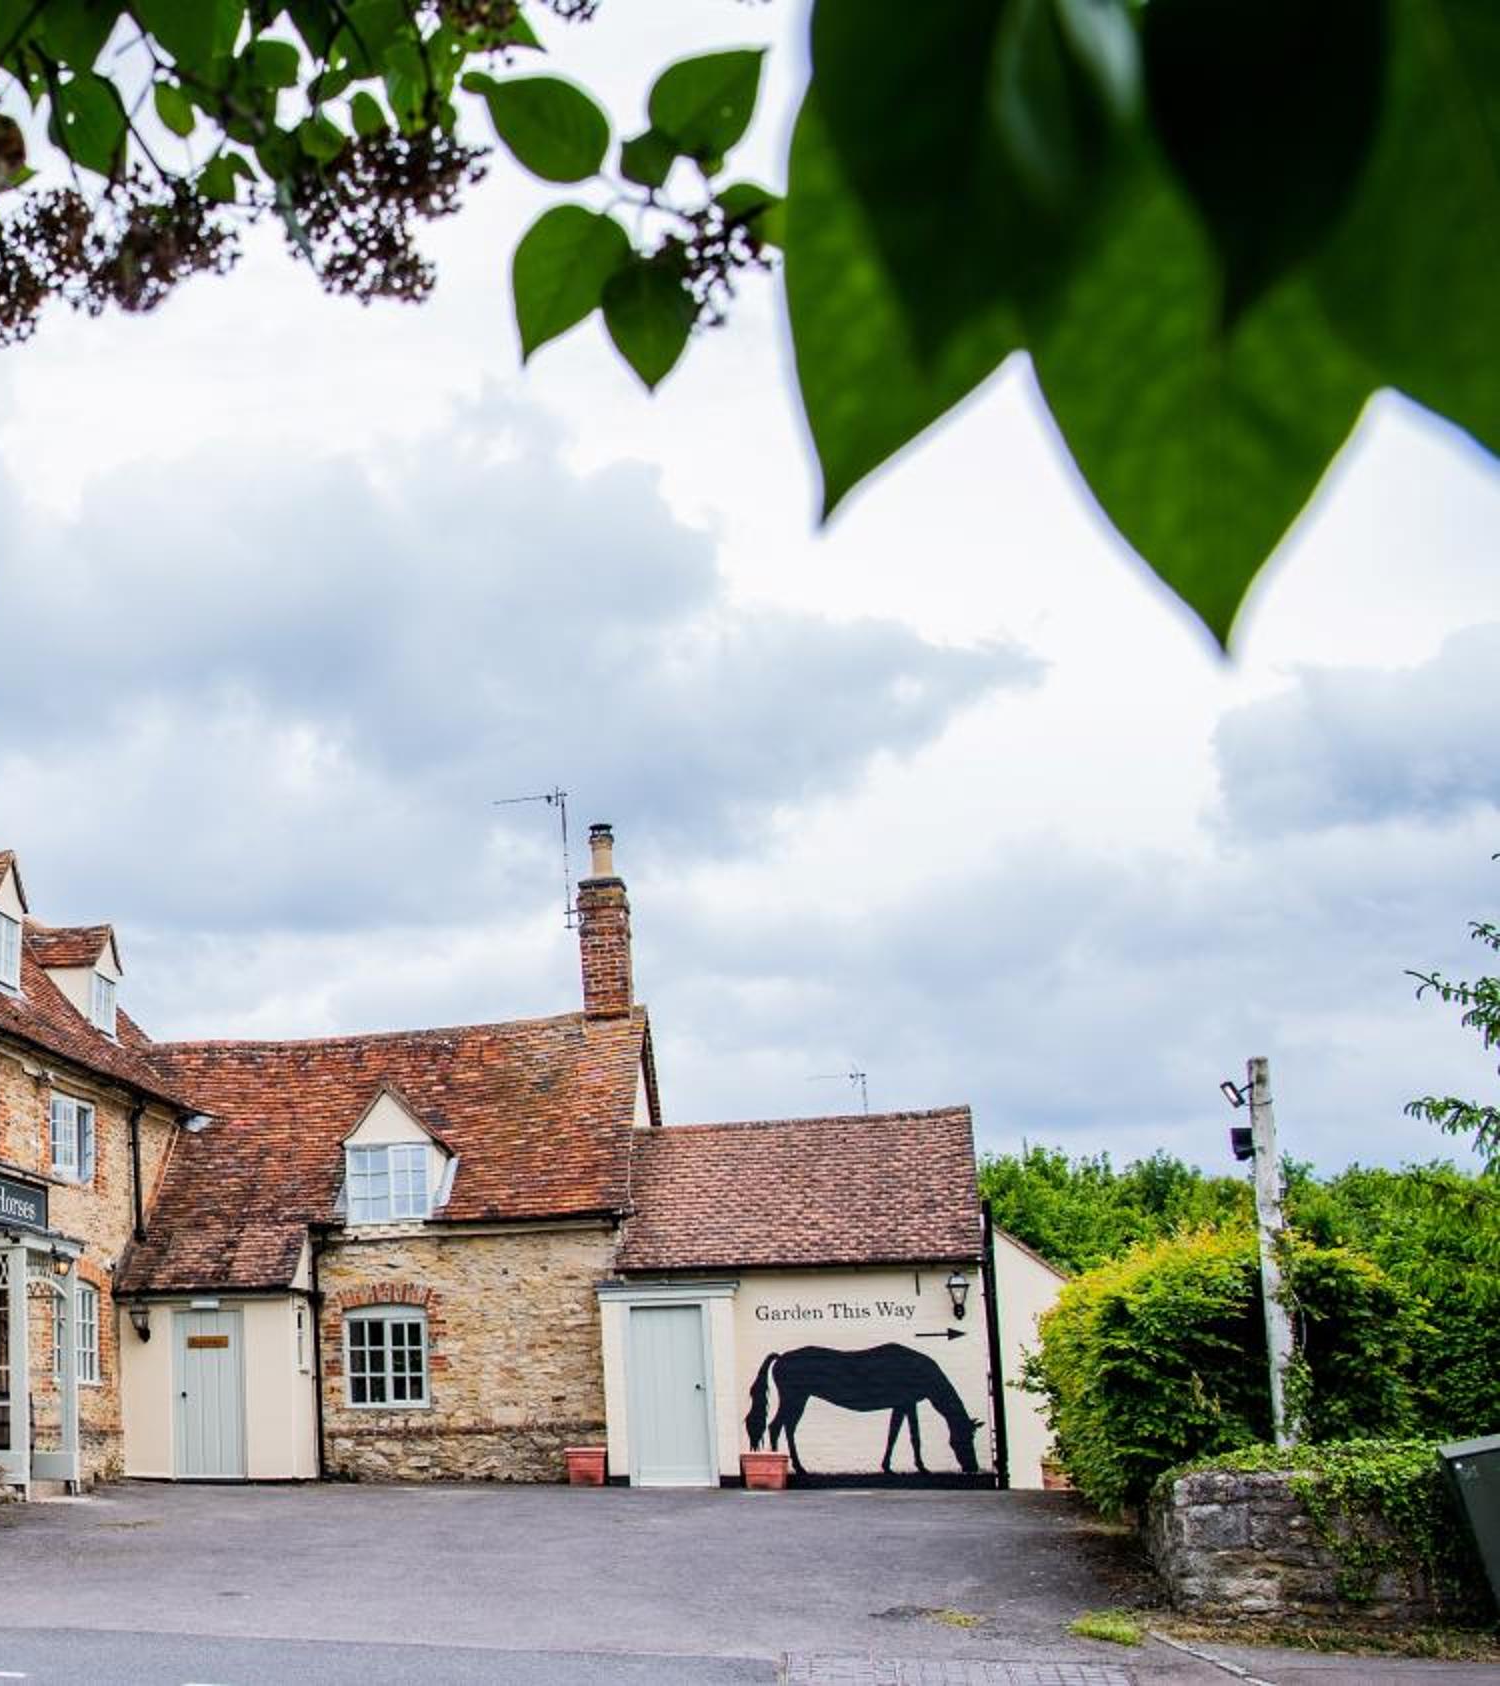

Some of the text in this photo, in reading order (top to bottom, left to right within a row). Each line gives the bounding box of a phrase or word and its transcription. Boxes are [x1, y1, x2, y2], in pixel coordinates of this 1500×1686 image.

[755, 1301, 916, 1321] Garden This Way
